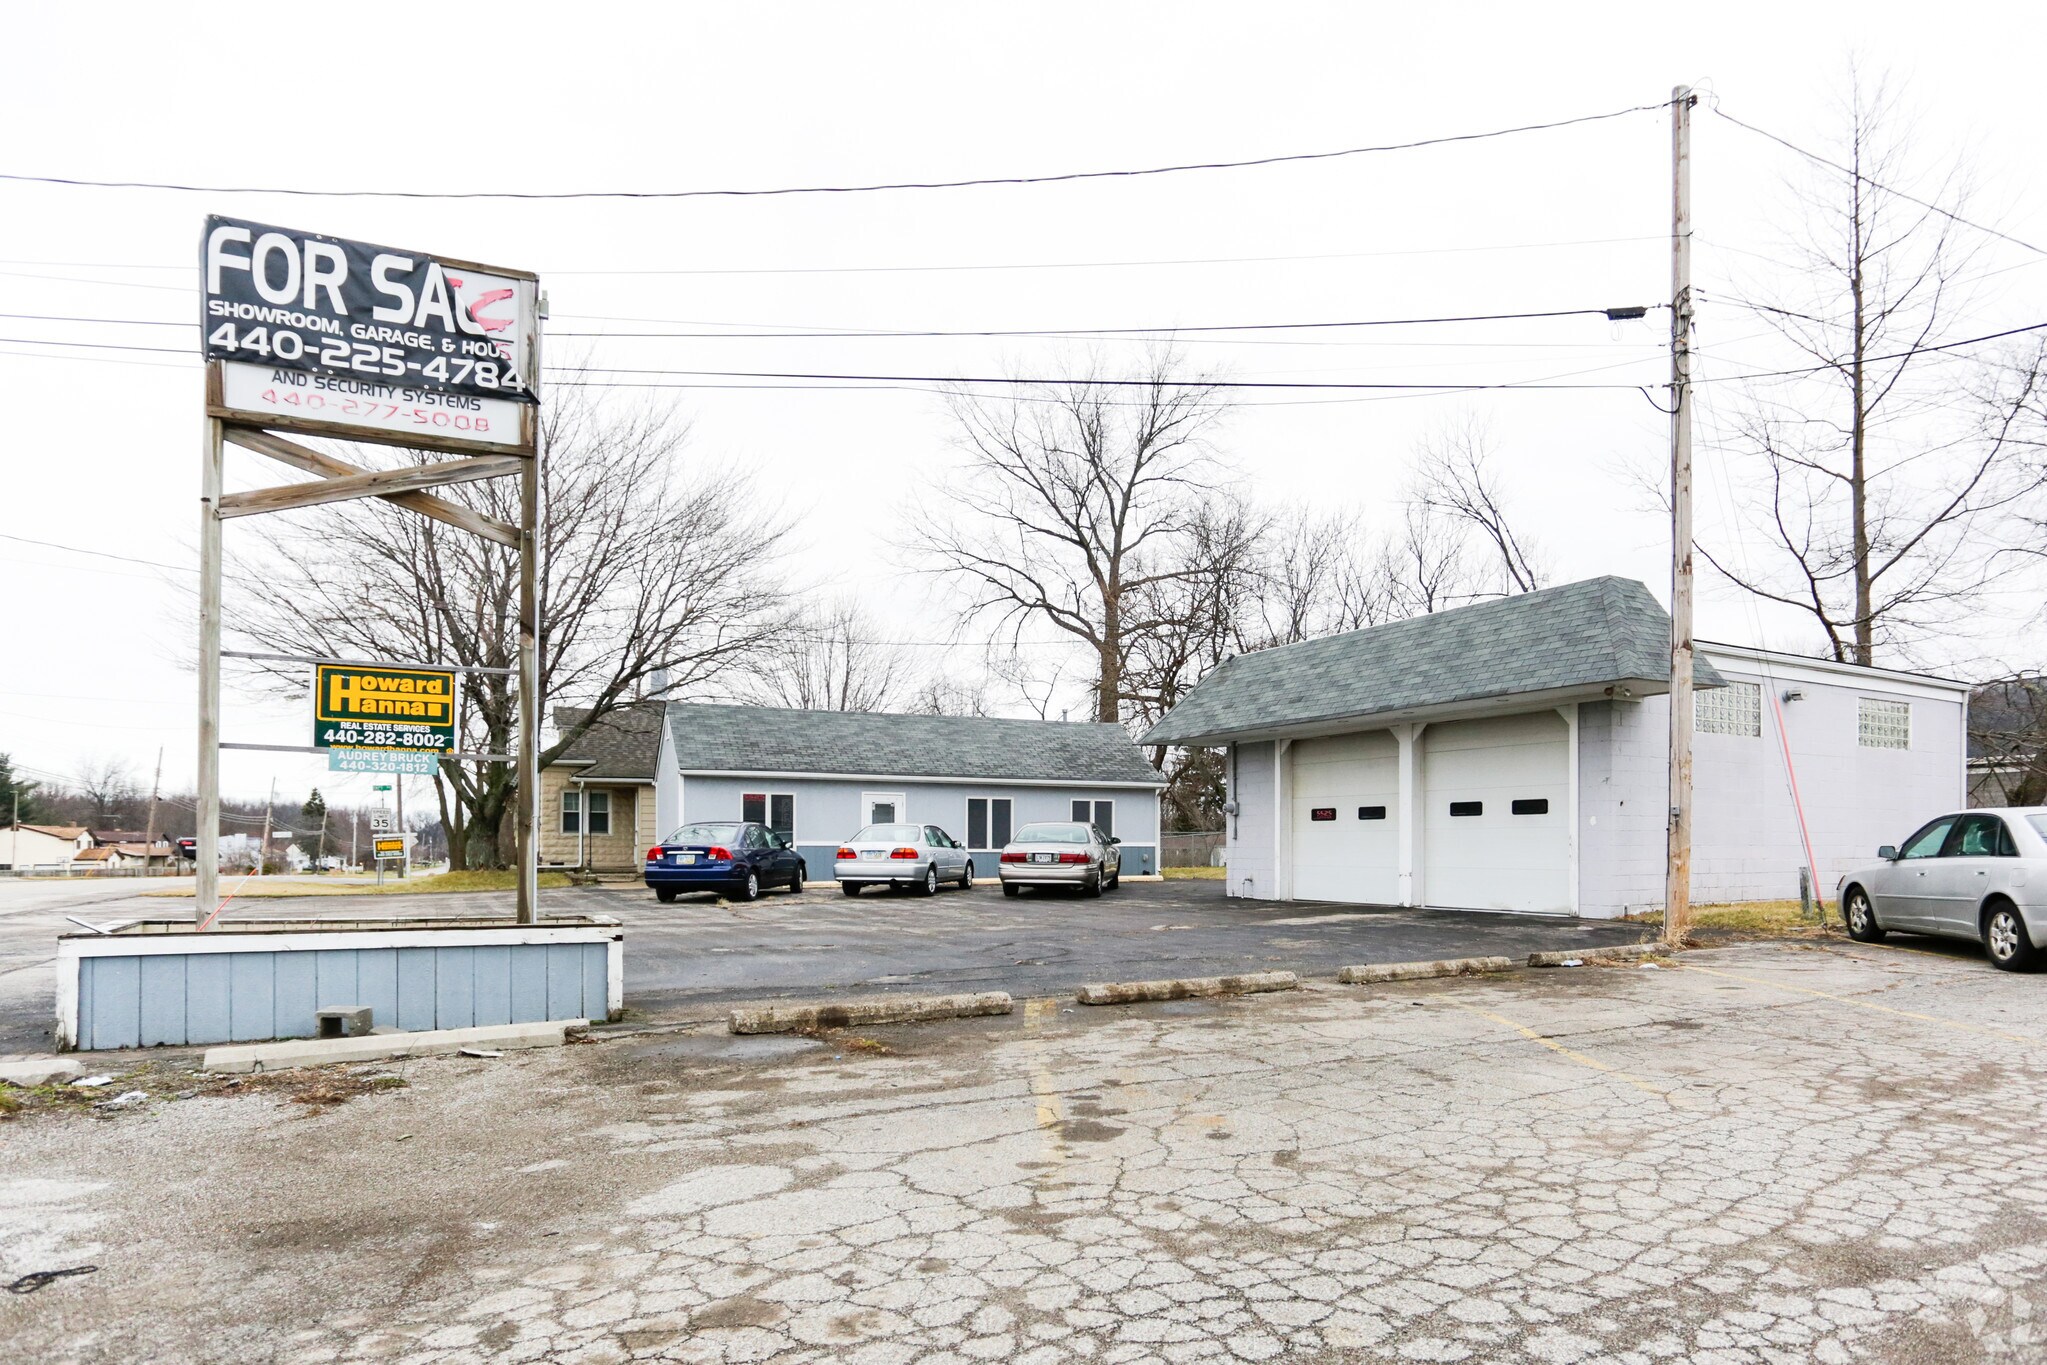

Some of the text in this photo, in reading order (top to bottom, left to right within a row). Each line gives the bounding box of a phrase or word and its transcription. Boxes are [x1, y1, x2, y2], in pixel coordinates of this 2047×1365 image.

[207, 226, 349, 316] FOR
[350, 323, 435, 352] GARAGE,
[441, 338, 456, 353] &
[208, 322, 526, 393] 440-225-4784
[271, 369, 481, 412] AND SECURITY SYSTEMS
[330, 674, 443, 707] Howard
[340, 721, 431, 734] REAL ESTATE SERVICES
[323, 729, 445, 748] 440-282-8002
[330, 744, 440, 754] wwwhowardhannacom
[338, 750, 431, 764] AUDREY BRUCK
[339, 760, 429, 773] 440-320-1812
[373, 818, 389, 828] 35
